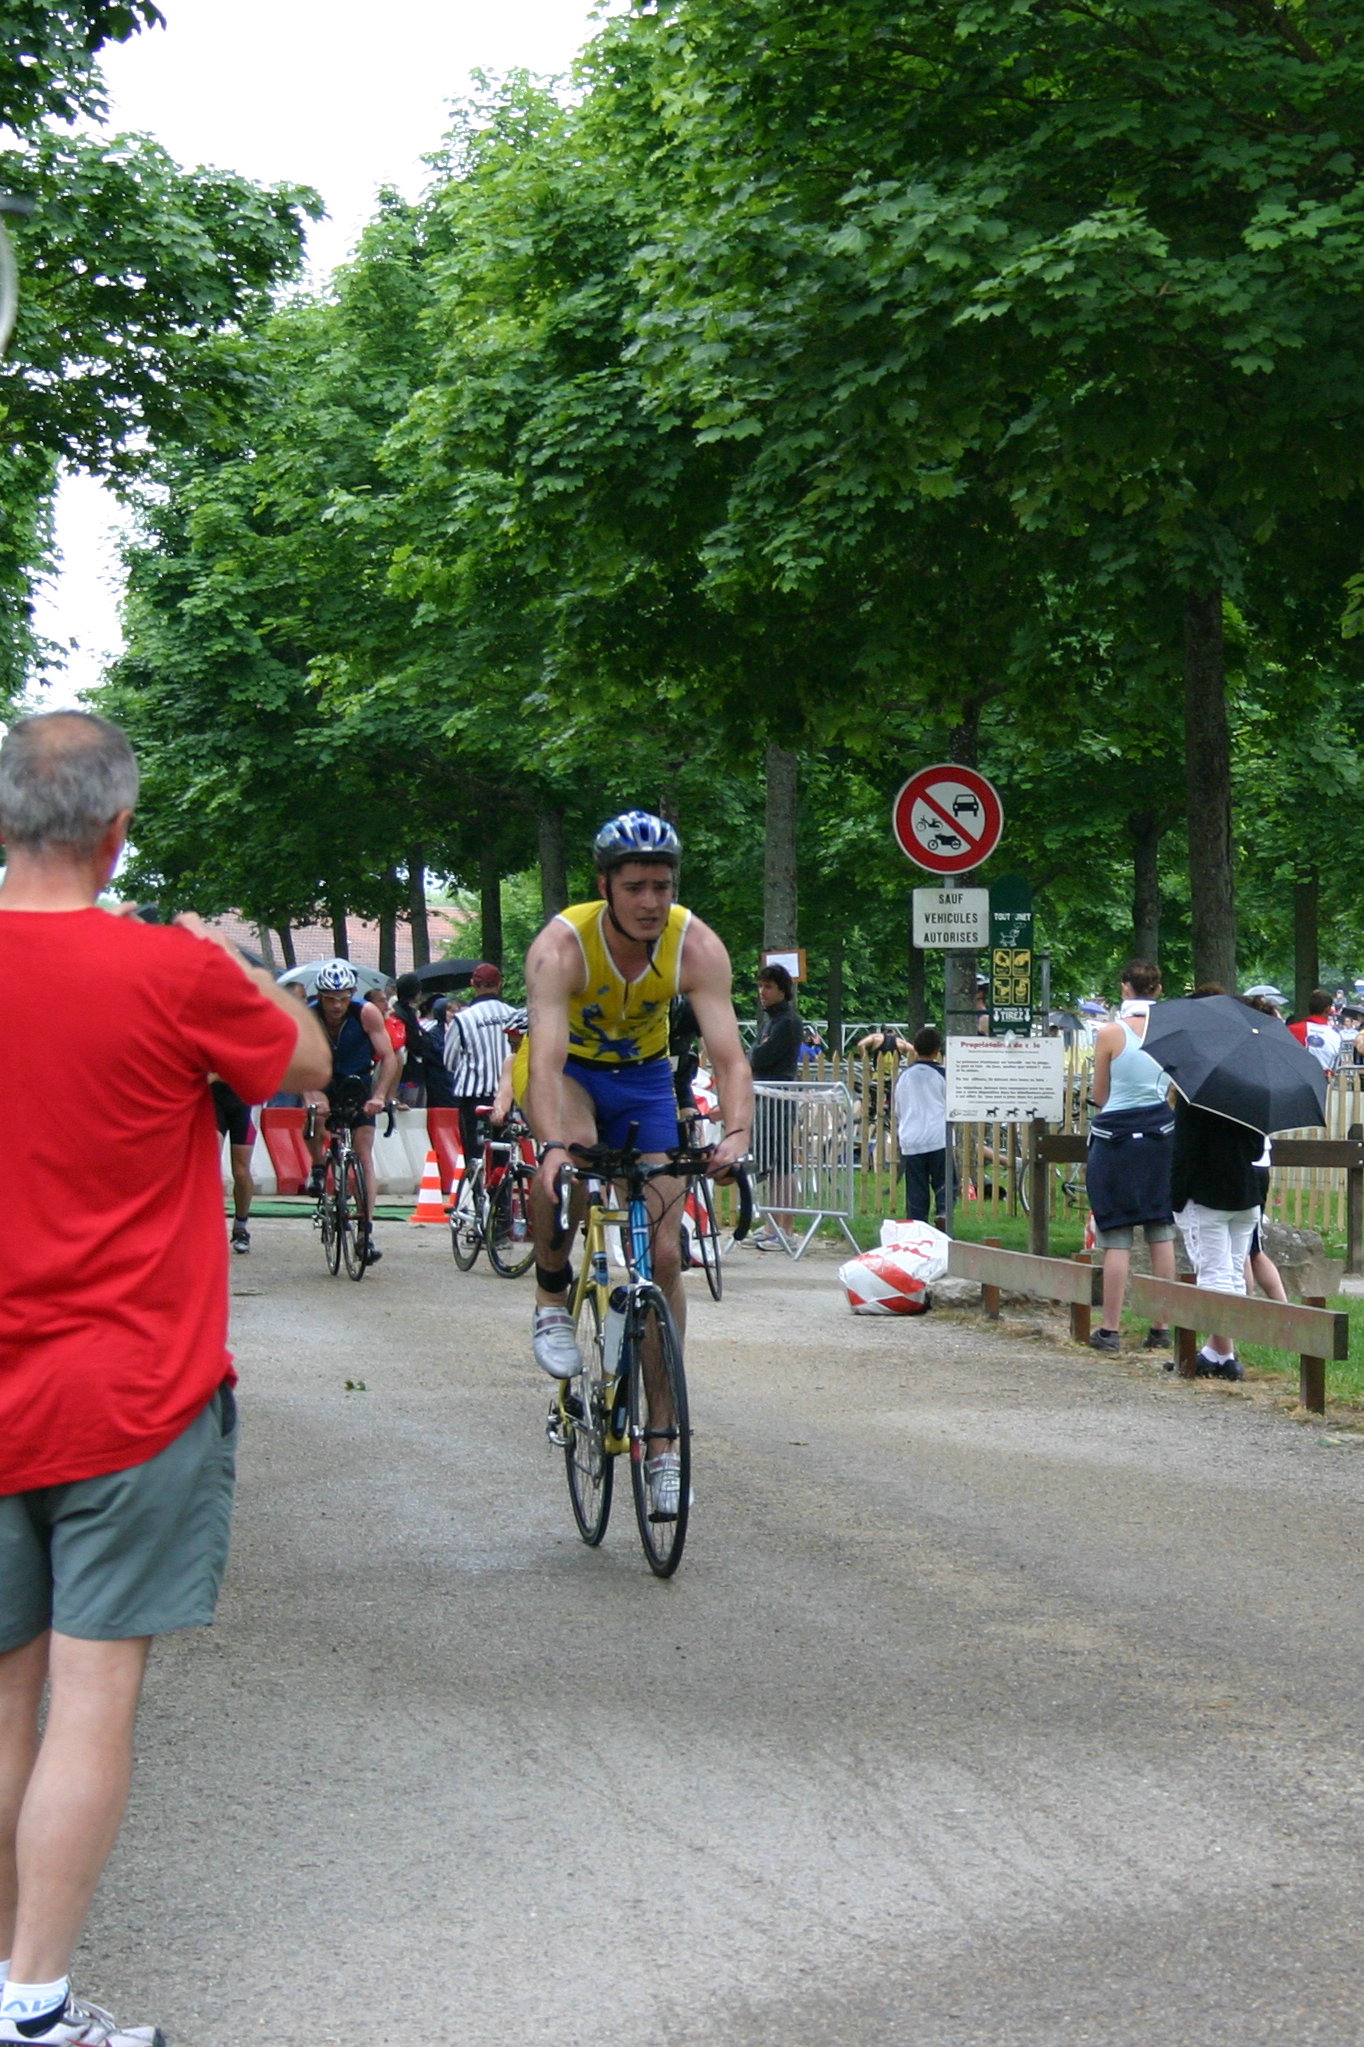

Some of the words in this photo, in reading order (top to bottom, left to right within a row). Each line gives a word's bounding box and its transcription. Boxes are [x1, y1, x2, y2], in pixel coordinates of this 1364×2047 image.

[939, 893, 963, 904] SAUF
[924, 912, 978, 924] VEHICULES
[924, 932, 978, 943] AUTORISES
[1000, 1011, 1024, 1020] TIREZ
